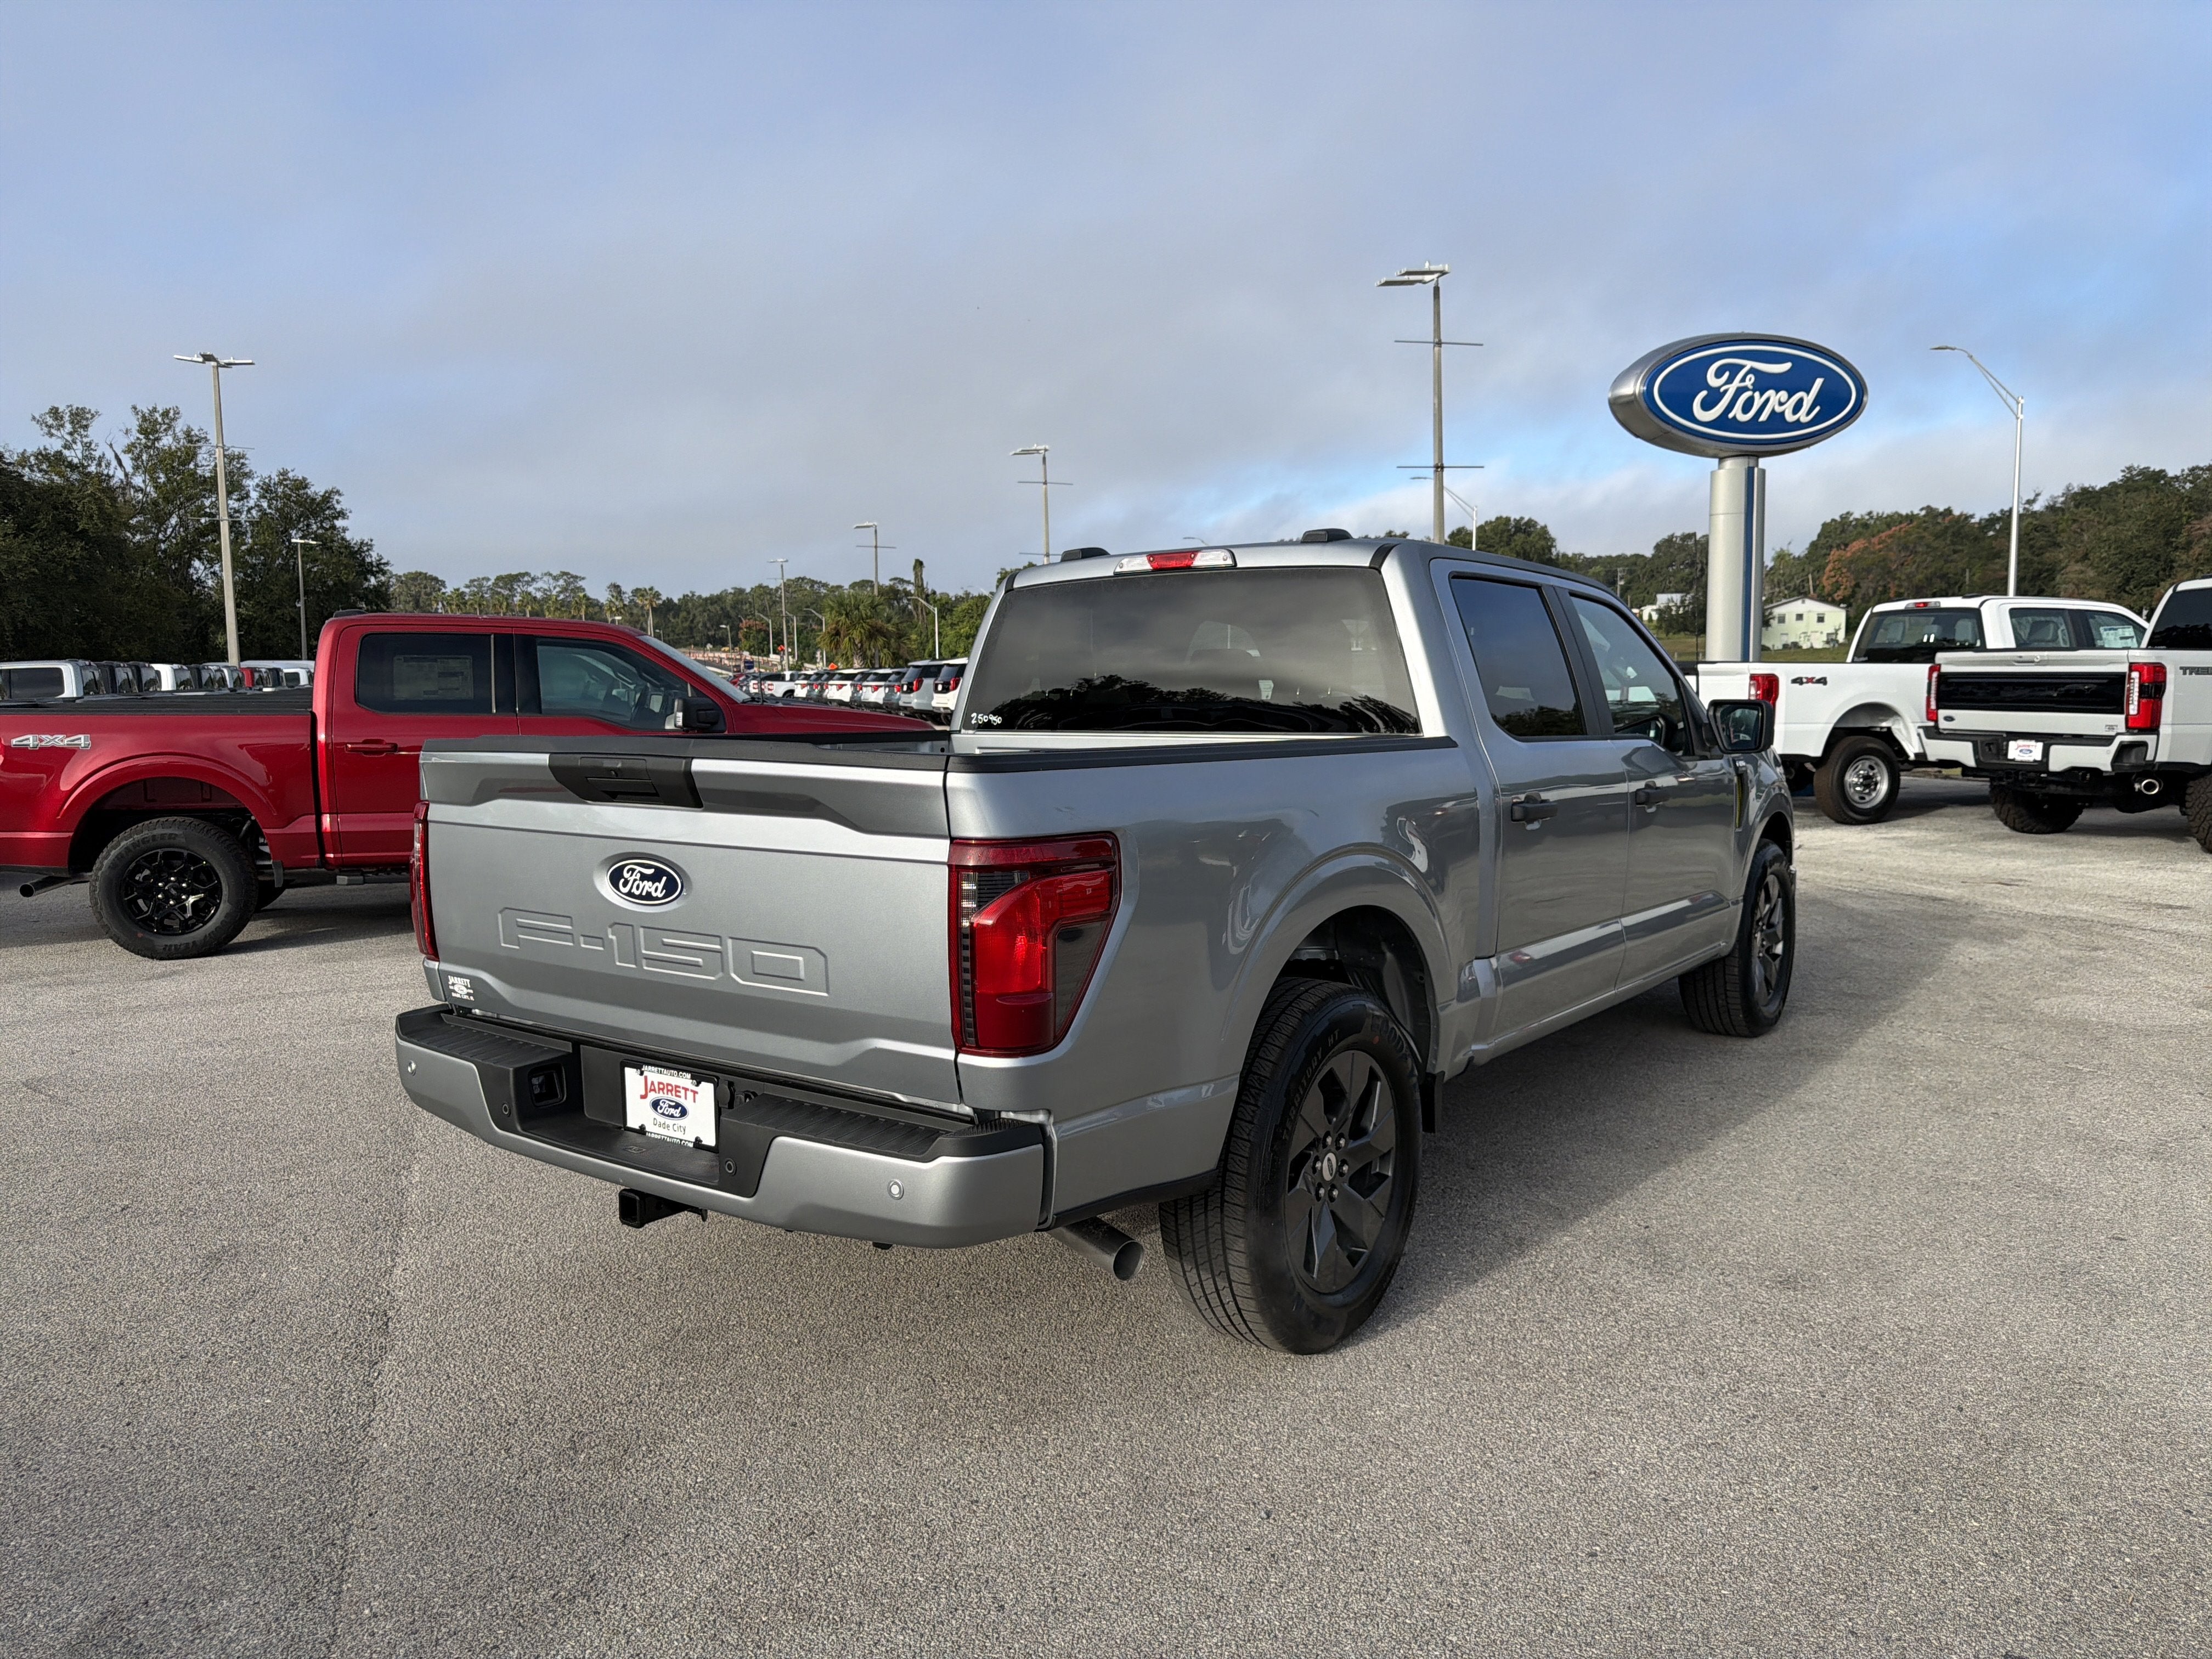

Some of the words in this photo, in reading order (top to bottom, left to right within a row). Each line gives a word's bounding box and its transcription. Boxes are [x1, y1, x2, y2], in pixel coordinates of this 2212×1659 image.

[1692, 358, 1825, 422] Ford
[970, 713, 1002, 725] 250950
[619, 865, 667, 898] Ford
[498, 907, 829, 996] F-150
[448, 975, 471, 988] JARRETT
[642, 1065, 691, 1079] JARRETTAUTO.COM
[640, 1075, 698, 1103] JARRETT
[657, 1099, 681, 1117] Ford
[653, 1118, 670, 1131] Dade
[672, 1123, 686, 1135] City
